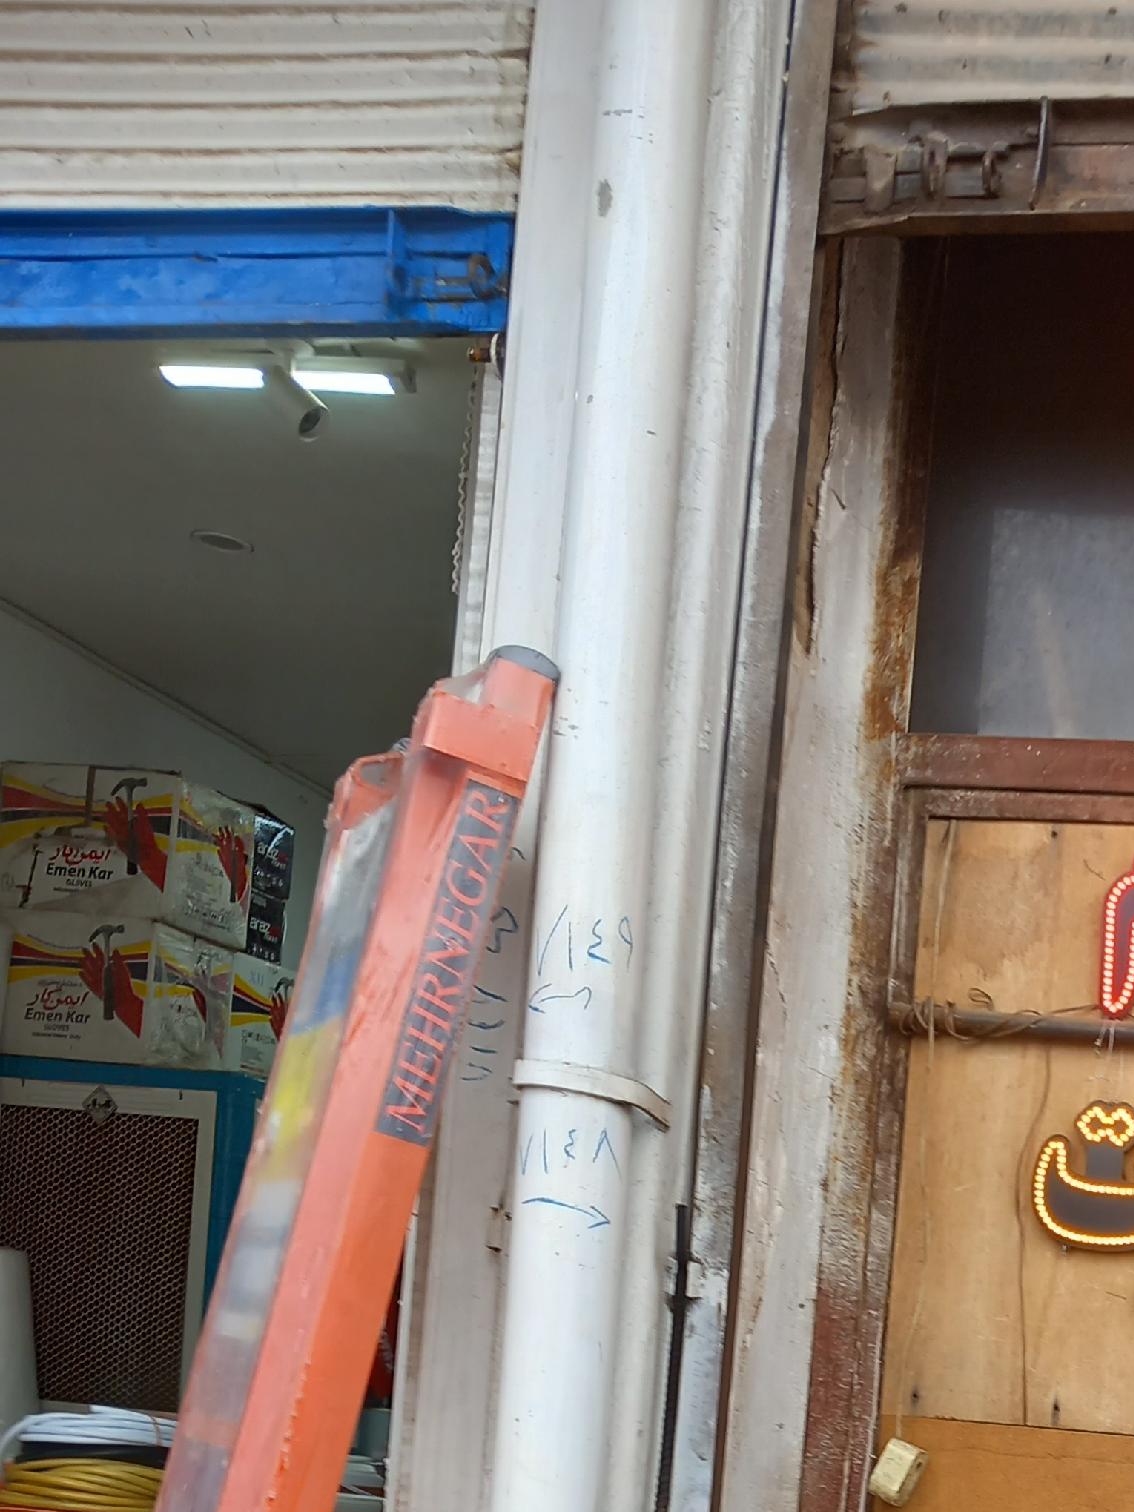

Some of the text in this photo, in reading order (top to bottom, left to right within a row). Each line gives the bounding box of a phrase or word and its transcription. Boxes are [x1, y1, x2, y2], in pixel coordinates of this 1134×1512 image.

[46, 863, 113, 880] Emen Kar
[386, 789, 511, 1133] MEHRNEGAR
[24, 1008, 90, 1024] Emen Kar
